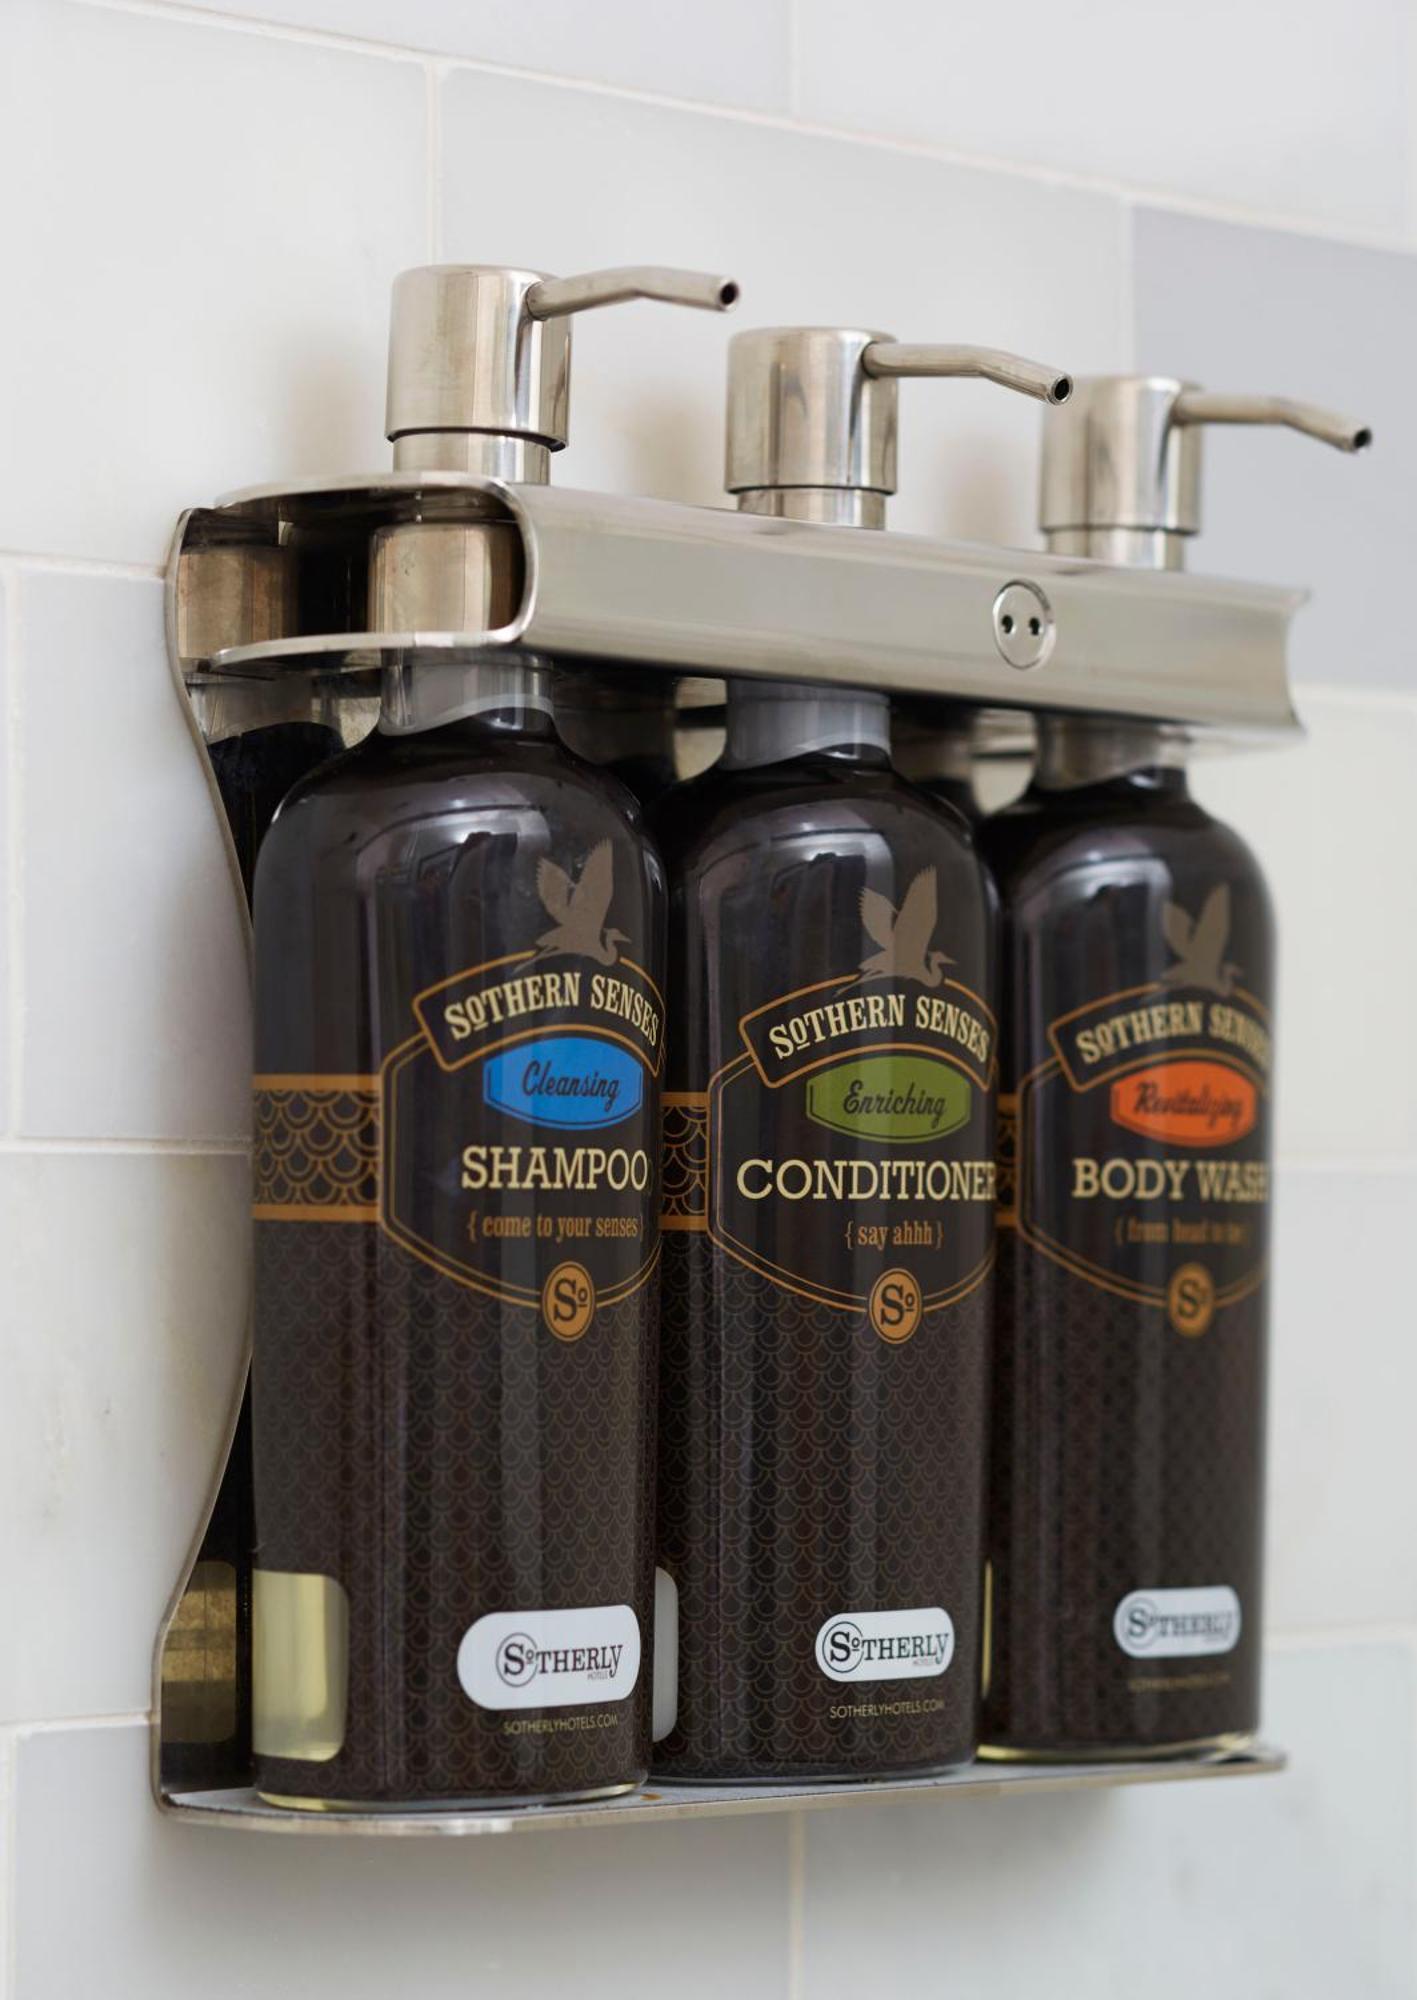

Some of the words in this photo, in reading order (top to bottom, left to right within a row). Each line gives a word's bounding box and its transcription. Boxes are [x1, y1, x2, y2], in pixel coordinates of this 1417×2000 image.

[444, 971, 581, 1041] SOTHERN
[590, 974, 659, 1047] SENSES
[768, 994, 906, 1060] SOTHERN
[915, 995, 989, 1064] SENSES
[521, 1060, 620, 1111] Cleansing
[842, 1079, 948, 1129] Enriching
[461, 1145, 648, 1190] SHAMPOO
[1071, 1157, 1191, 1199] BODY
[482, 1215, 532, 1238] come
[536, 1213, 553, 1238] to
[555, 1215, 592, 1243] your
[595, 1215, 639, 1238] senses
[857, 1225, 889, 1251] say
[893, 1222, 932, 1245] ahhh
[503, 1713, 618, 1735] SOTHERLYHOTELS.COM
